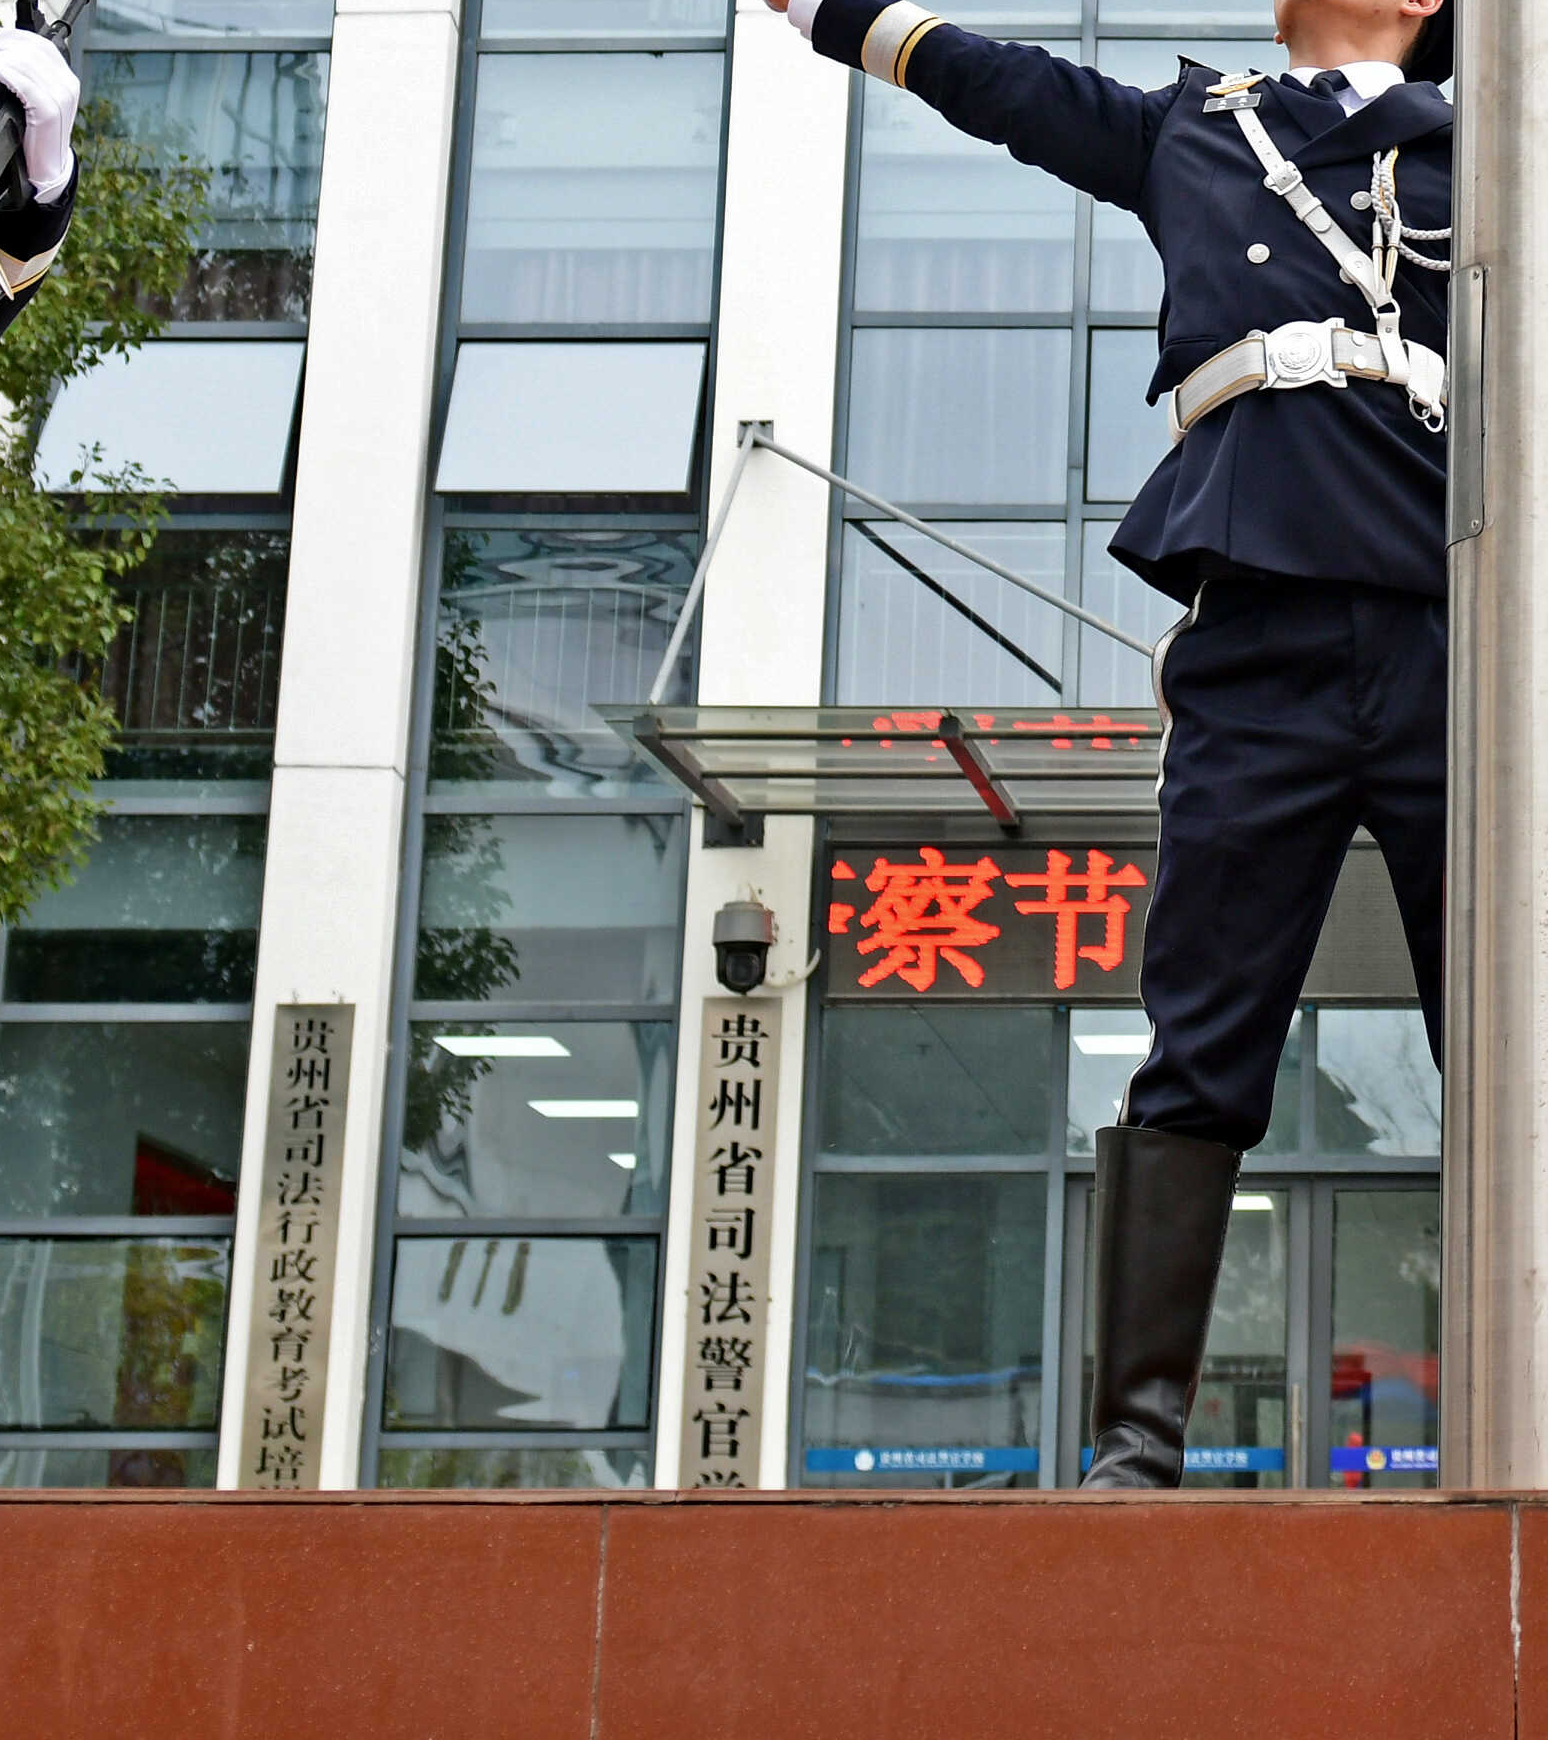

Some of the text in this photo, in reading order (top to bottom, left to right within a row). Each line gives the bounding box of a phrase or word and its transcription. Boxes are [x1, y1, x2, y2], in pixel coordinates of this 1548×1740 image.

[828, 846, 1147, 993] 察节
[254, 1018, 335, 1489] 贵州省司法行政教育考试培
